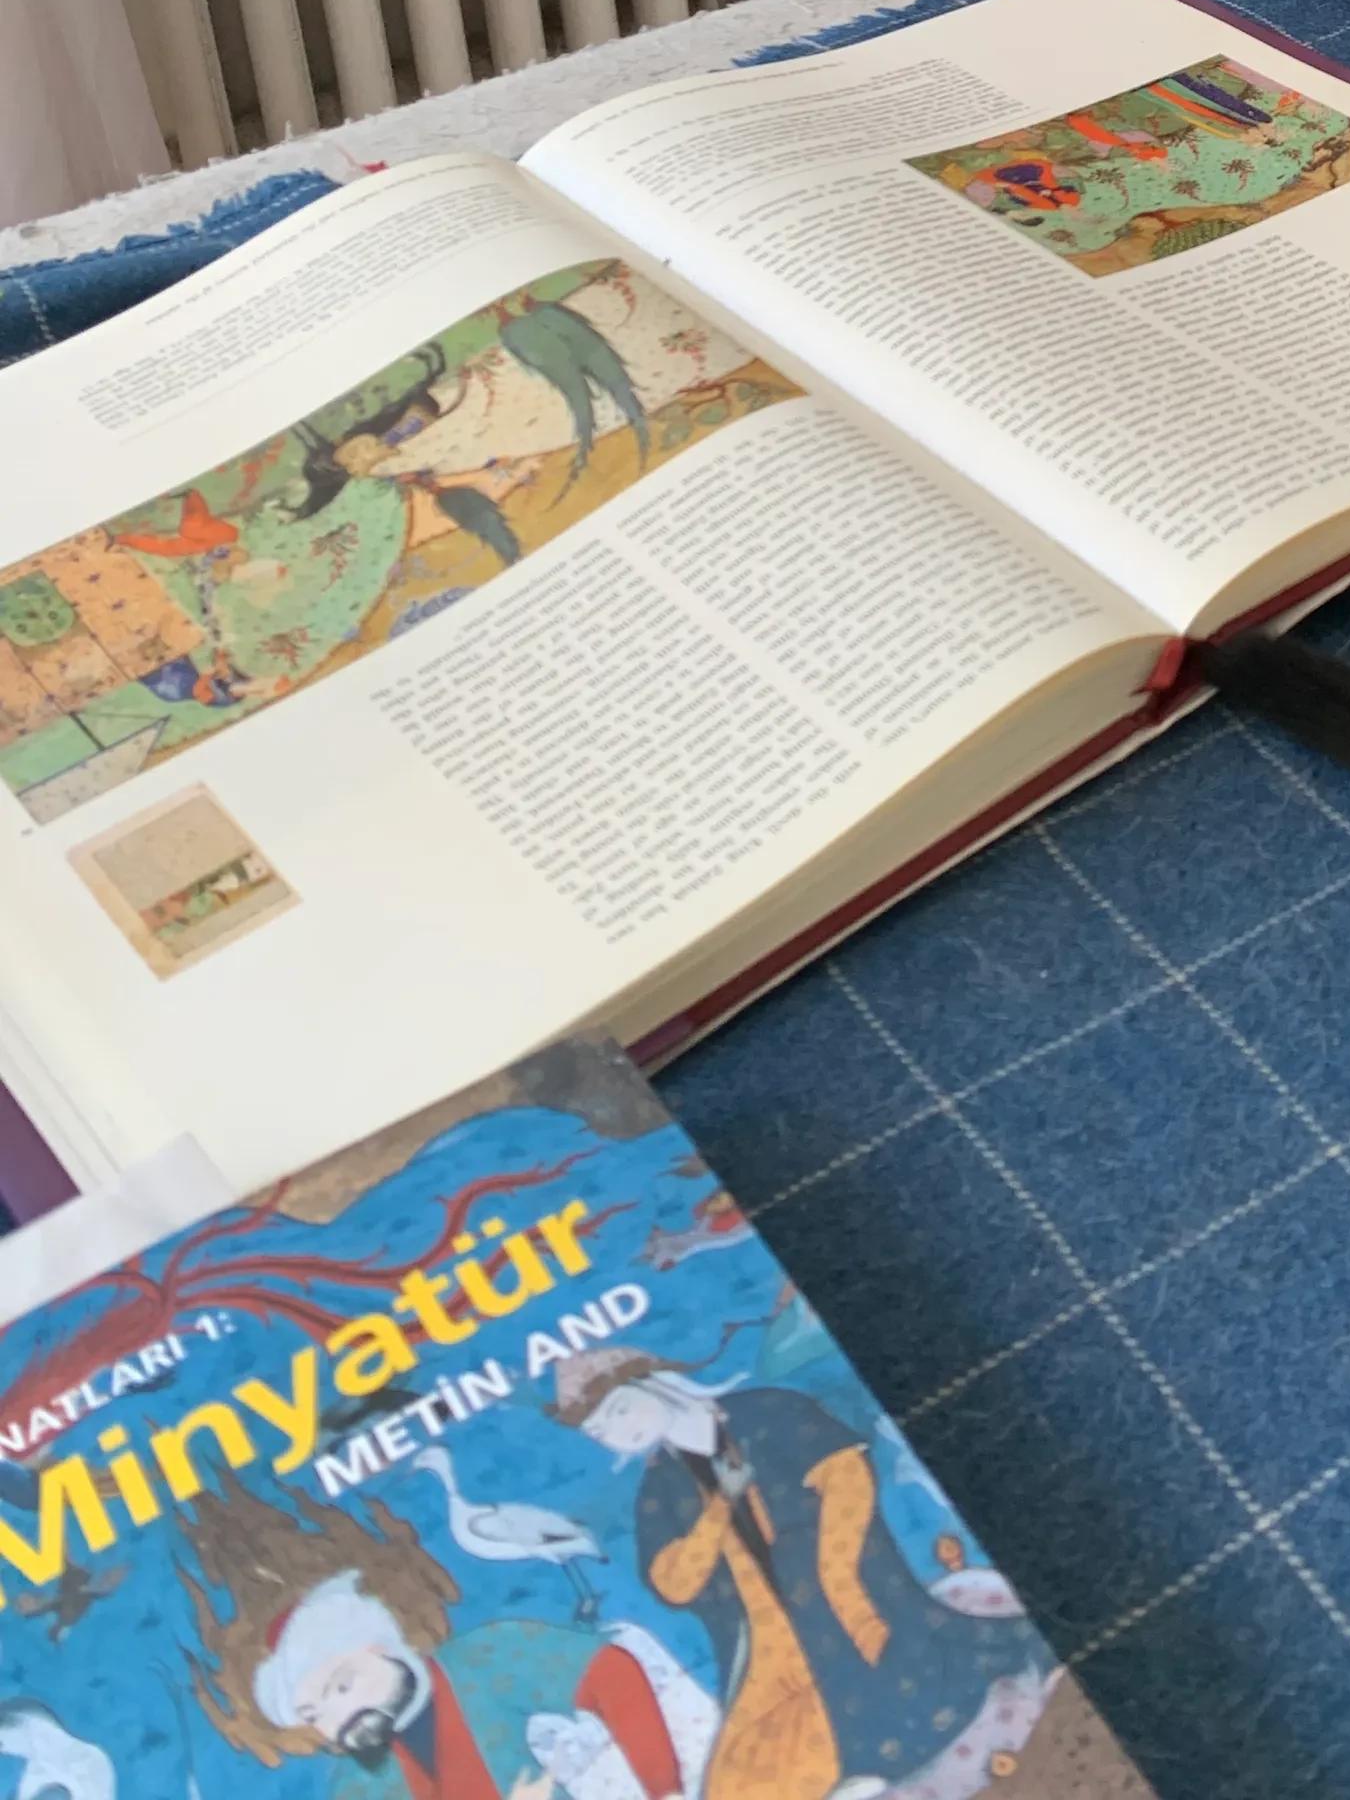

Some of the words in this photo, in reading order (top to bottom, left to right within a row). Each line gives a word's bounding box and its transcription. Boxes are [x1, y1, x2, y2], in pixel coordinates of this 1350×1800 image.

[194, 1311, 238, 1342] 1:
[313, 1359, 513, 1498] METİN
[525, 1283, 650, 1379] AND
